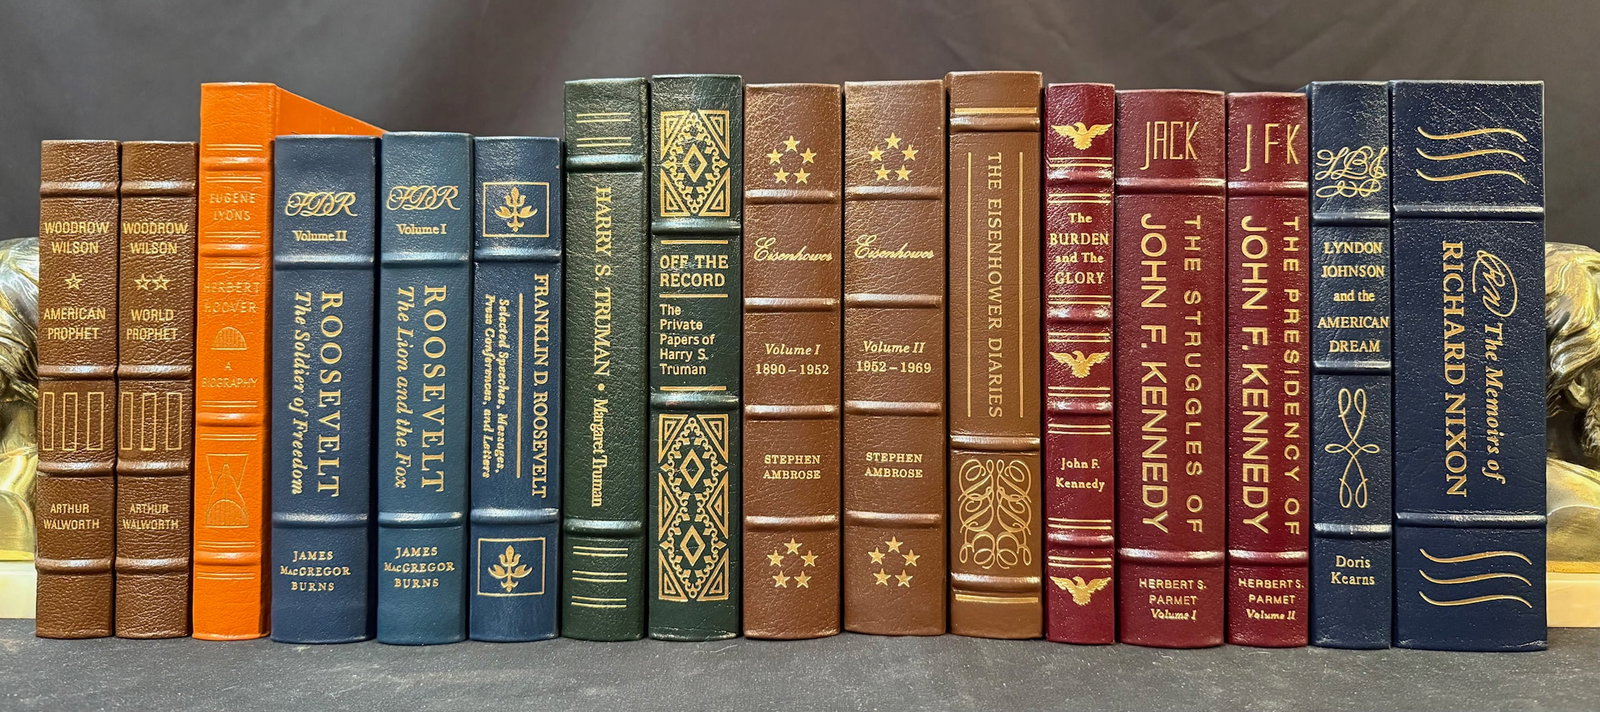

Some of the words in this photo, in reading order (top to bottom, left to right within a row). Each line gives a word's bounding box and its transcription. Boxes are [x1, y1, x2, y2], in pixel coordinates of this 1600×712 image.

[1139, 121, 1200, 171] JACK
[987, 152, 1002, 190] THE
[210, 192, 256, 203] EUGENE
[285, 191, 358, 217] FDR
[386, 185, 461, 211] FDR
[213, 209, 251, 221] LYONS
[595, 186, 612, 257] HARRY
[1068, 212, 1093, 224] The
[45, 221, 109, 235] WOODROW
[123, 222, 187, 235] WOODROW
[292, 230, 333, 241] Volume
[335, 230, 348, 241] II
[396, 224, 439, 235] Volume
[440, 224, 447, 235] I
[1049, 232, 1110, 246] BURDEN
[1184, 215, 1201, 271] THE
[1283, 216, 1300, 272] THE
[51, 241, 99, 254] WILSON
[130, 242, 177, 254] WILSON
[753, 237, 833, 262] Eisenhower
[854, 235, 935, 259] Eisenhower
[1323, 242, 1383, 254] LYNDON
[659, 255, 689, 269] OFF
[694, 255, 729, 269] THE
[987, 199, 1002, 331] EISENHOWER
[1055, 252, 1079, 263] and
[1081, 252, 1104, 264] The
[1140, 213, 1167, 308] JOHN
[1241, 215, 1269, 310] JOHN
[594, 264, 611, 281] S.
[1054, 272, 1105, 285] GLORY
[1320, 265, 1385, 278] JOHNSON
[659, 273, 725, 287] RECORD
[1333, 290, 1355, 302] and
[1357, 290, 1376, 302] the
[294, 291, 312, 325] The
[397, 286, 415, 322] The
[485, 294, 496, 325] Press
[659, 303, 681, 316] The
[43, 307, 106, 320] AMERICAN
[131, 309, 174, 321] WORLD
[534, 273, 550, 367] FRANKLIN
[1442, 240, 1466, 385] RICHARD
[498, 299, 511, 349] Selected
[659, 319, 703, 330] Private
[1317, 316, 1389, 329] AMERICAN
[48, 328, 100, 340] PROPHET
[127, 328, 178, 340] PROPHET
[593, 286, 611, 377] TRUMAN
[1141, 324, 1167, 348] F.
[1241, 326, 1268, 351] F.
[659, 334, 700, 347] Papers
[701, 333, 716, 345] of
[863, 340, 911, 354] Volume
[912, 342, 926, 354] II
[1329, 340, 1381, 353] DREAM
[1484, 323, 1503, 361] The
[396, 326, 414, 372] Lion
[659, 348, 693, 362] Harry
[697, 348, 708, 360] S.
[765, 343, 812, 356] Volume
[814, 344, 821, 356] I
[224, 361, 232, 371] A
[293, 329, 311, 394] Soldier
[482, 328, 496, 405] Conferences,
[659, 363, 707, 375] Truman
[496, 351, 510, 409] Speeches,
[533, 371, 549, 386] D.
[988, 337, 1003, 418] DIARIES
[1184, 289, 1203, 476] STRUGGLES
[1283, 288, 1300, 482] PRESIDENCY
[317, 291, 344, 497] ROOSEVELT
[396, 376, 414, 415] and
[421, 285, 447, 492] ROOSEVELT
[288, 396, 309, 417] of
[1484, 365, 1505, 455] Memoirs
[483, 409, 495, 433] and
[590, 398, 609, 454] Margaret
[395, 418, 413, 447] the
[494, 413, 509, 473] Messages,
[532, 391, 549, 498] ROOSEVELT
[1141, 361, 1169, 534] KENNEDY
[1241, 363, 1269, 535] KENNEDY
[1444, 392, 1468, 498] NIXON
[291, 417, 308, 495] Freedom
[482, 434, 493, 479] Letters
[764, 454, 821, 465] STEPHEN
[865, 451, 923, 463] STEPHEN
[394, 451, 412, 488] Fox
[1061, 458, 1089, 470] John
[1091, 459, 1100, 469] F.
[763, 470, 821, 480] AMBROSE
[864, 467, 923, 478] AMBROSE
[1482, 460, 1506, 484] of
[591, 454, 608, 507] Truman
[1055, 477, 1105, 493] Kennedy
[50, 503, 90, 514] ARTHUR
[129, 503, 169, 514] ARTHUR
[1186, 494, 1203, 533] OF
[1284, 498, 1300, 535] OF
[43, 519, 100, 530] WALWORTH
[122, 519, 179, 530] WALWORTH
[292, 550, 334, 562] JAMES
[394, 547, 438, 559] JAMES
[1335, 555, 1371, 569] Doris
[291, 581, 335, 591] BURNS
[394, 578, 439, 589] BURNS
[1138, 578, 1195, 589] HERBERT
[1196, 578, 1207, 589] S.
[1238, 577, 1294, 589] HERBERT
[1295, 578, 1305, 589] S.
[1330, 571, 1375, 586] Kearns
[1149, 595, 1198, 605] PARMET
[1248, 594, 1296, 605] PARMET
[1150, 609, 1189, 620] Volume
[1189, 610, 1197, 621] I
[1246, 608, 1285, 620] Volume
[1286, 610, 1296, 620] II
